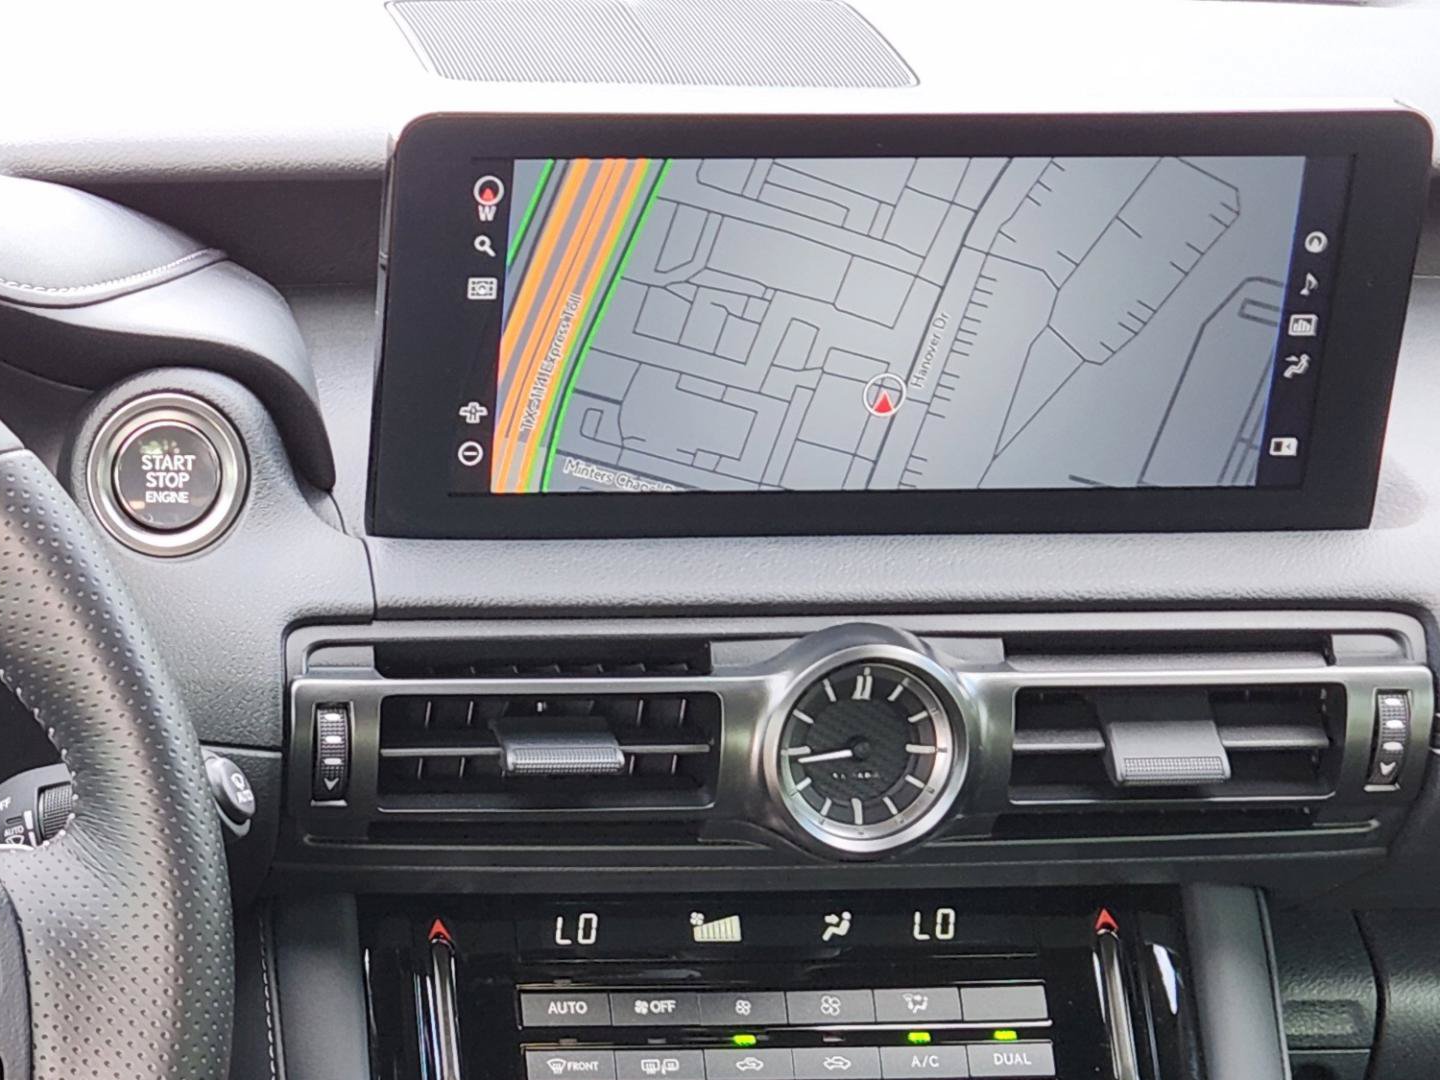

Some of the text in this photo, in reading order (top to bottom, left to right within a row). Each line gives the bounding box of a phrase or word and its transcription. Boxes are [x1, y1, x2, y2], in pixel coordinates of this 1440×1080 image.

[910, 313, 950, 389] Hanover Dr
[141, 455, 196, 471] START
[565, 459, 613, 485] Minters
[145, 472, 190, 488] STOP
[145, 491, 190, 503] ENGINE
[4, 825, 25, 837] AUTO
[547, 1001, 587, 1015] AUTO
[650, 1001, 676, 1015] OFF
[567, 1060, 600, 1071] FRONT
[911, 1055, 940, 1067] A/C
[993, 1052, 1032, 1065] DUAL
